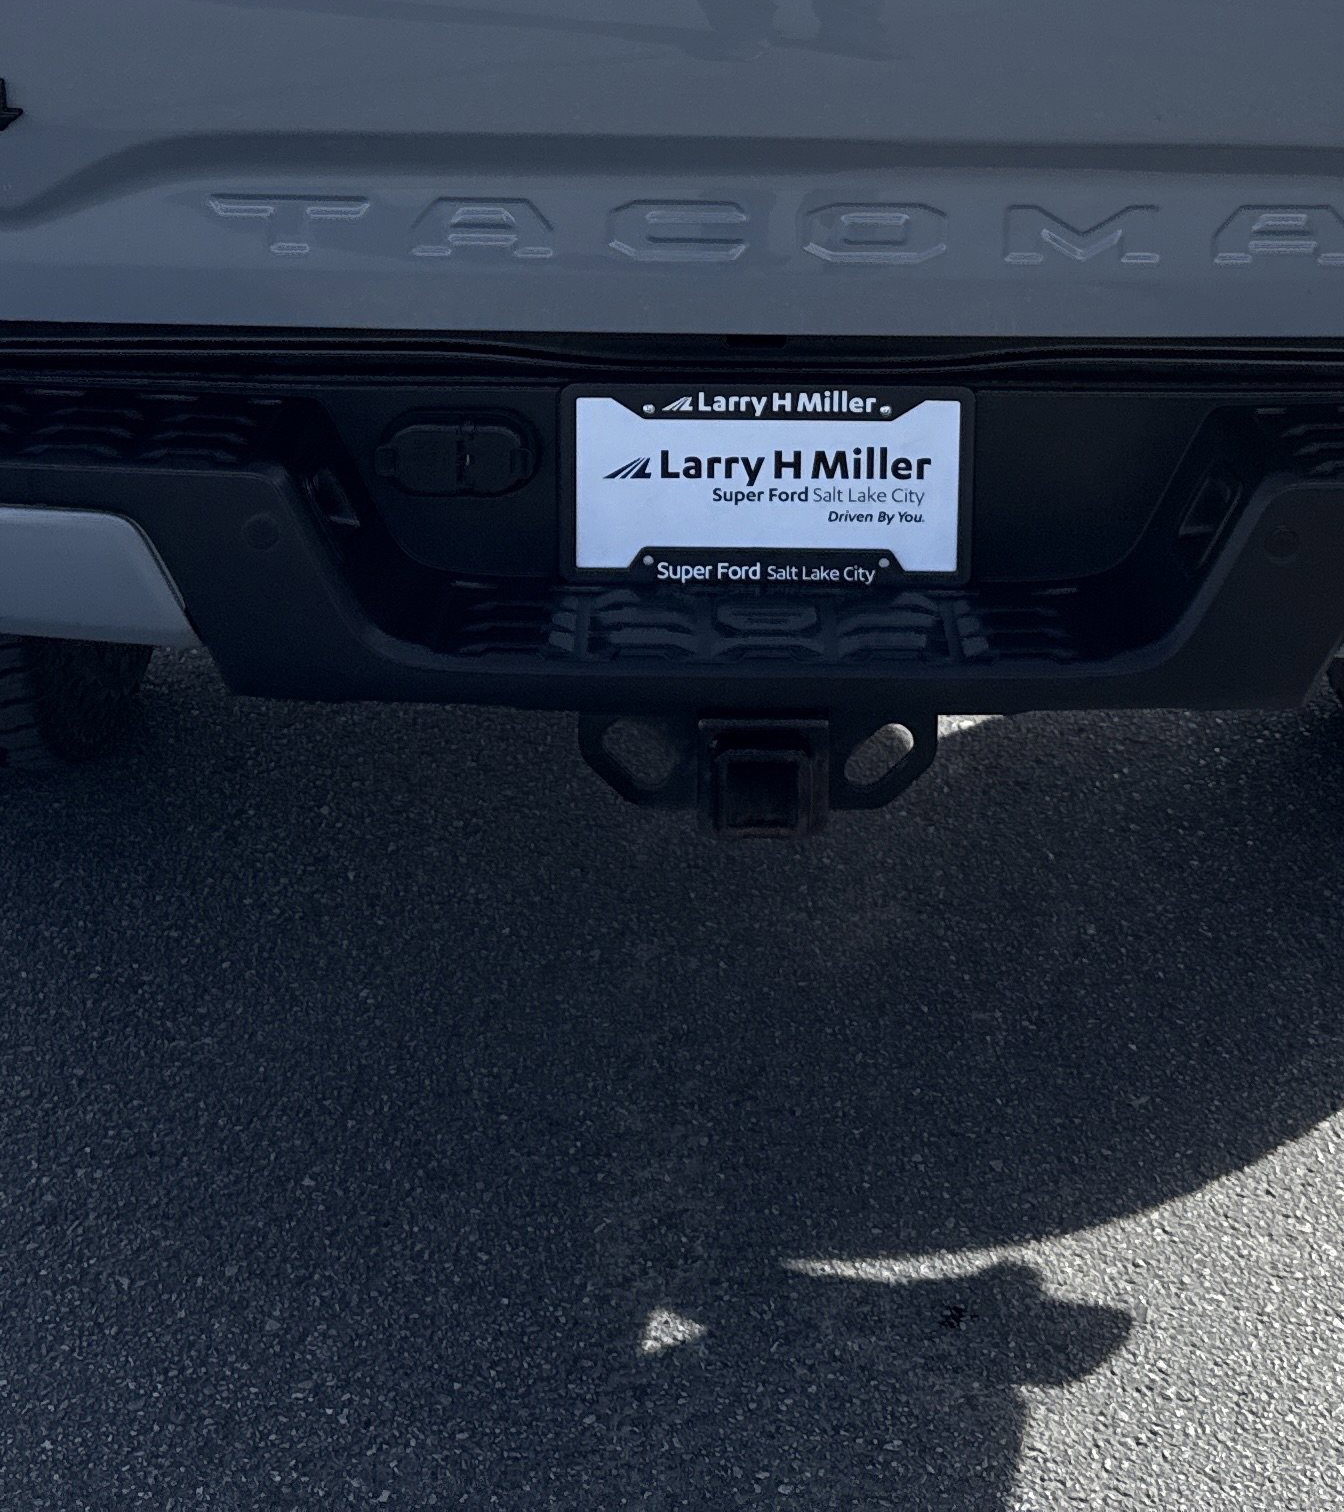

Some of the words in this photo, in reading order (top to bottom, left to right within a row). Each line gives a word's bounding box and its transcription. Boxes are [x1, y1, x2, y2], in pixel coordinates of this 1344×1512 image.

[698, 391, 767, 416] Larry
[772, 392, 792, 412] H
[797, 390, 876, 413] Miller
[660, 449, 765, 487] Larry
[774, 450, 802, 479] H
[811, 446, 932, 480] Miller
[712, 487, 764, 505] Super
[768, 486, 809, 502] Ford
[813, 487, 844, 503] Salt
[848, 487, 887, 503] Lake
[891, 487, 926, 506] City
[828, 510, 873, 523] Driven
[877, 511, 895, 525] By
[656, 561, 713, 581] Super
[717, 562, 761, 580] Ford
[767, 565, 799, 581] Salt
[802, 565, 840, 582] Lake
[843, 565, 876, 585] City
